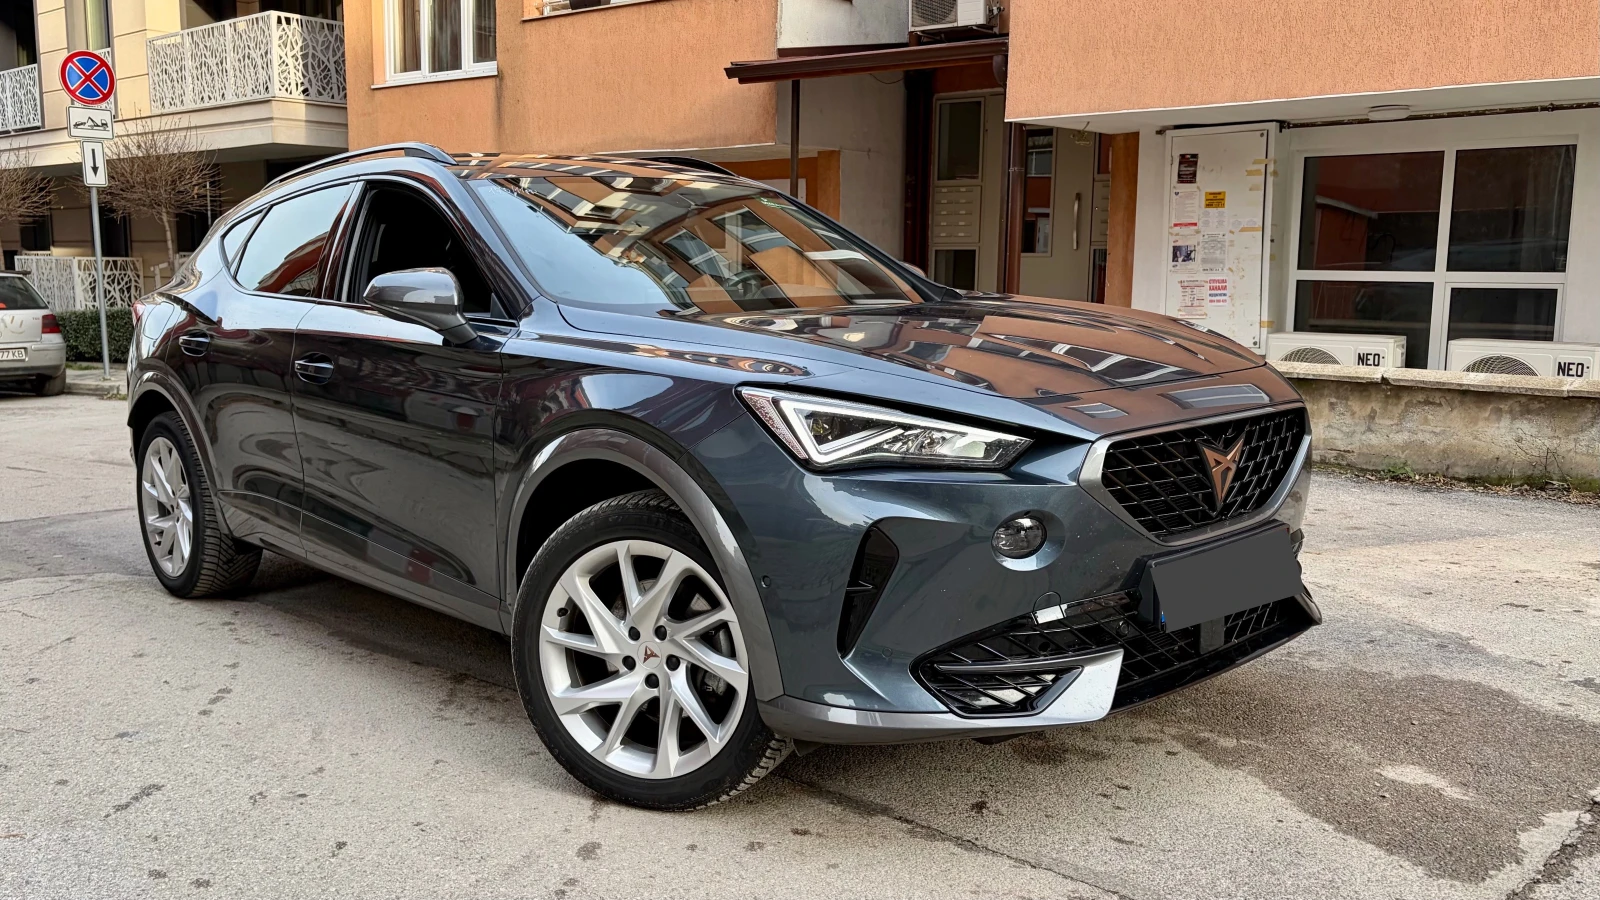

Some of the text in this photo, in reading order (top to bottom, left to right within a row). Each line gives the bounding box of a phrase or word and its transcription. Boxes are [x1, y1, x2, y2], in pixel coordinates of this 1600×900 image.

[12, 350, 24, 358] KB
[1357, 352, 1380, 367] NEO
[1557, 361, 1585, 378] NEO
